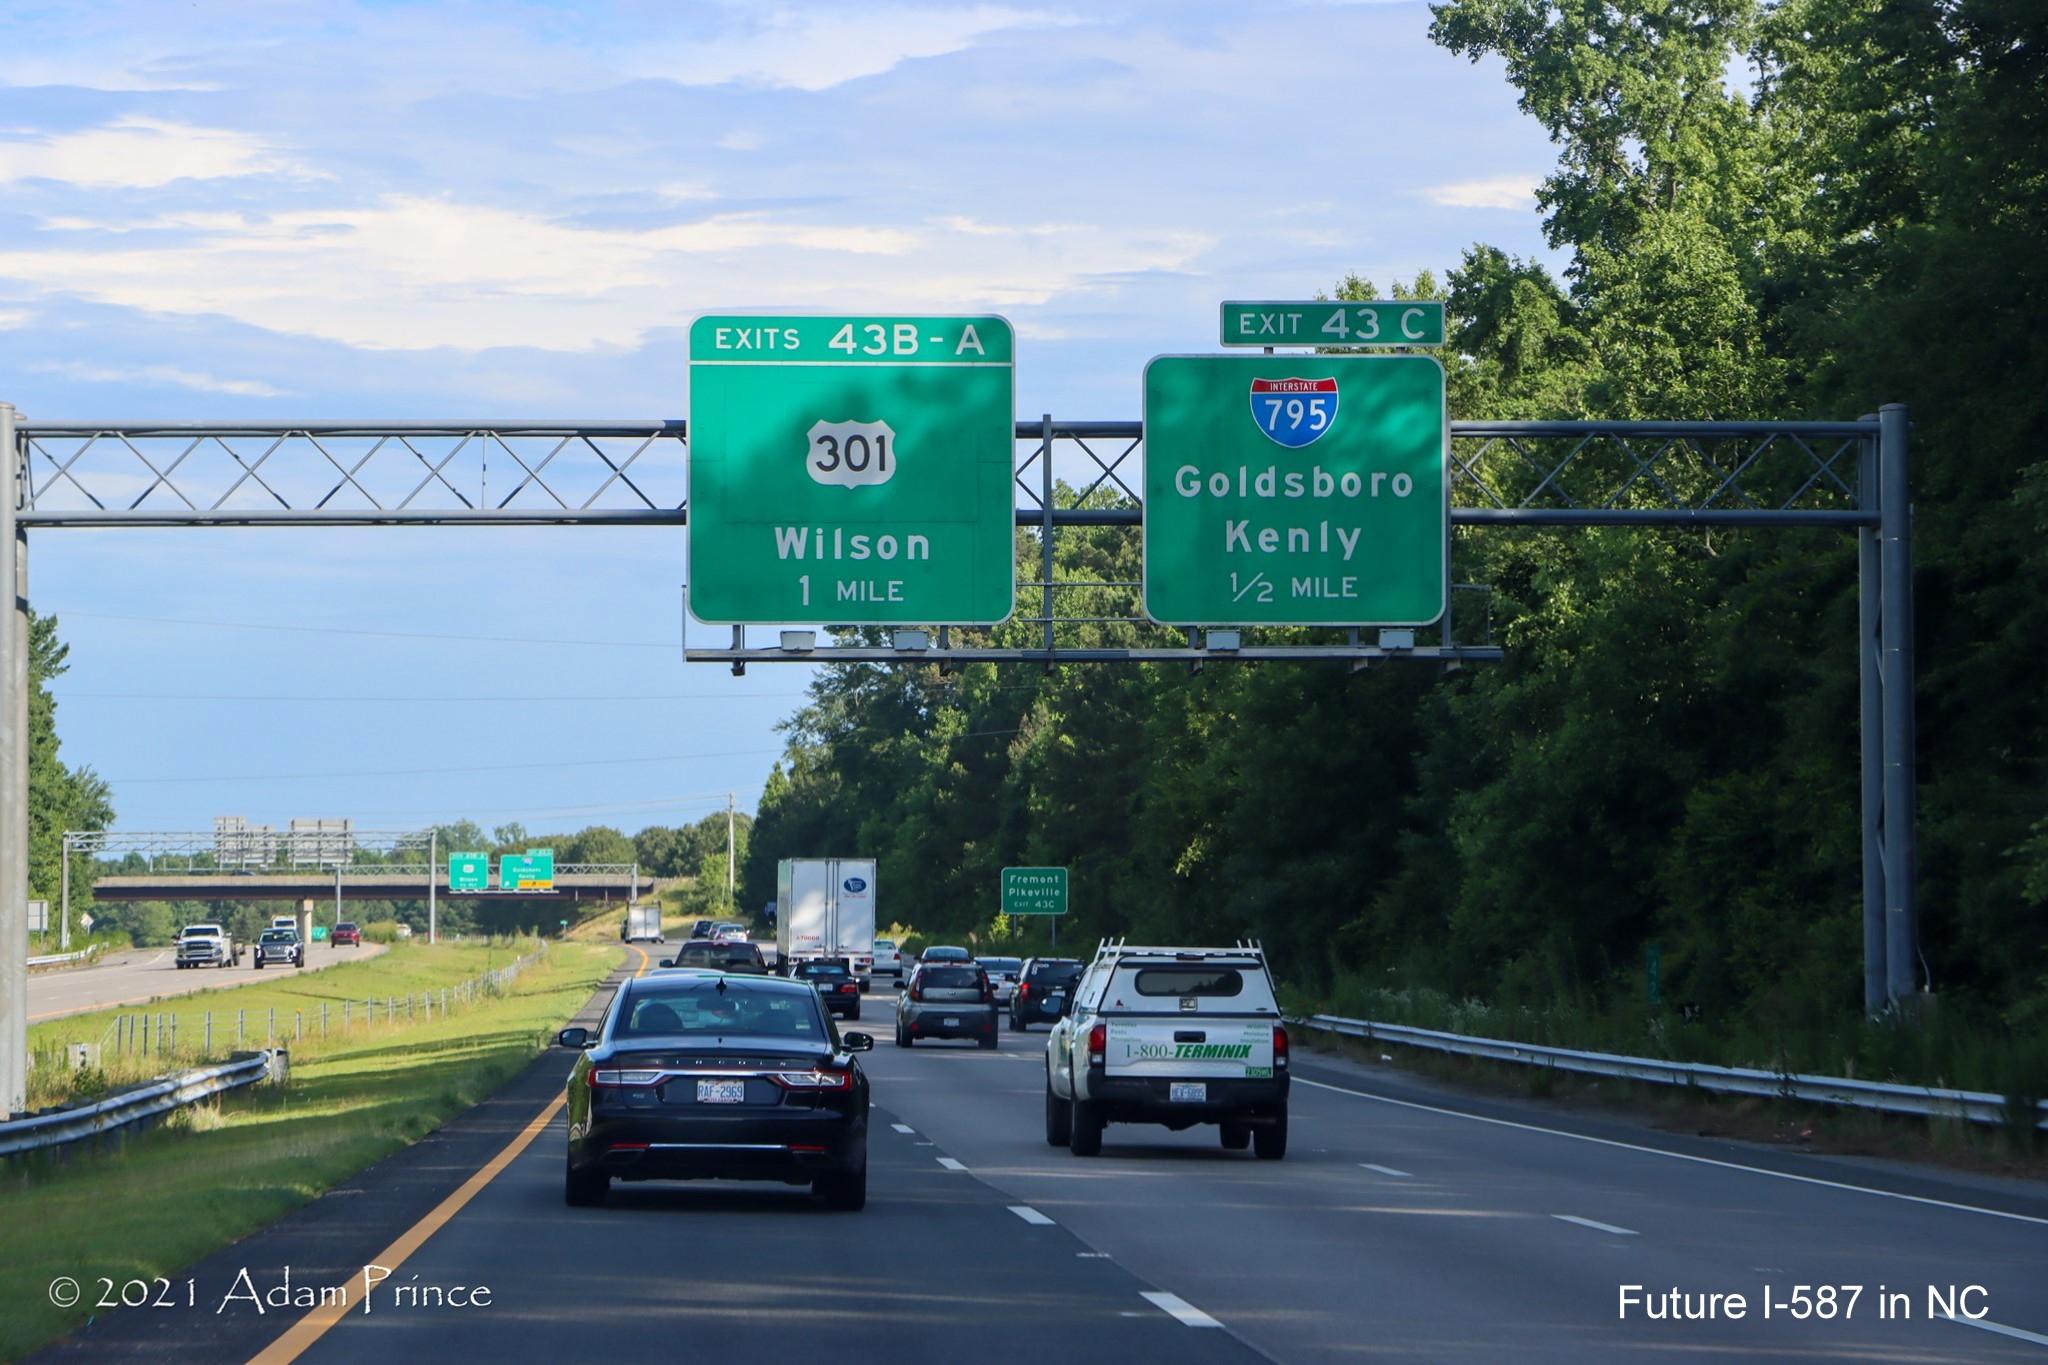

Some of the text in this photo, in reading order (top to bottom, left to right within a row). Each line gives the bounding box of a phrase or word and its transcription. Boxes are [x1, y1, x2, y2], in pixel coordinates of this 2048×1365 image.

[715, 327, 800, 350] EXITS
[1239, 307, 1425, 339] EXIT 43 C
[1269, 381, 1318, 392] INTERSTATE
[1264, 398, 1327, 431] 795
[815, 434, 887, 473] 301
[1174, 464, 1413, 498] Goldsboro
[774, 526, 930, 560] Wilson
[1225, 519, 1362, 561] Kenly
[798, 574, 905, 606] 1 MILE
[1230, 571, 1358, 603] 1/2 MILE
[1008, 887, 1061, 897] Pikeville
[1009, 874, 1059, 884] Fremont
[1014, 900, 1055, 909] EXIT 43C
[1126, 1043, 1252, 1059] 1-800-TERMINIX
[698, 1085, 743, 1098] RAF-2969
